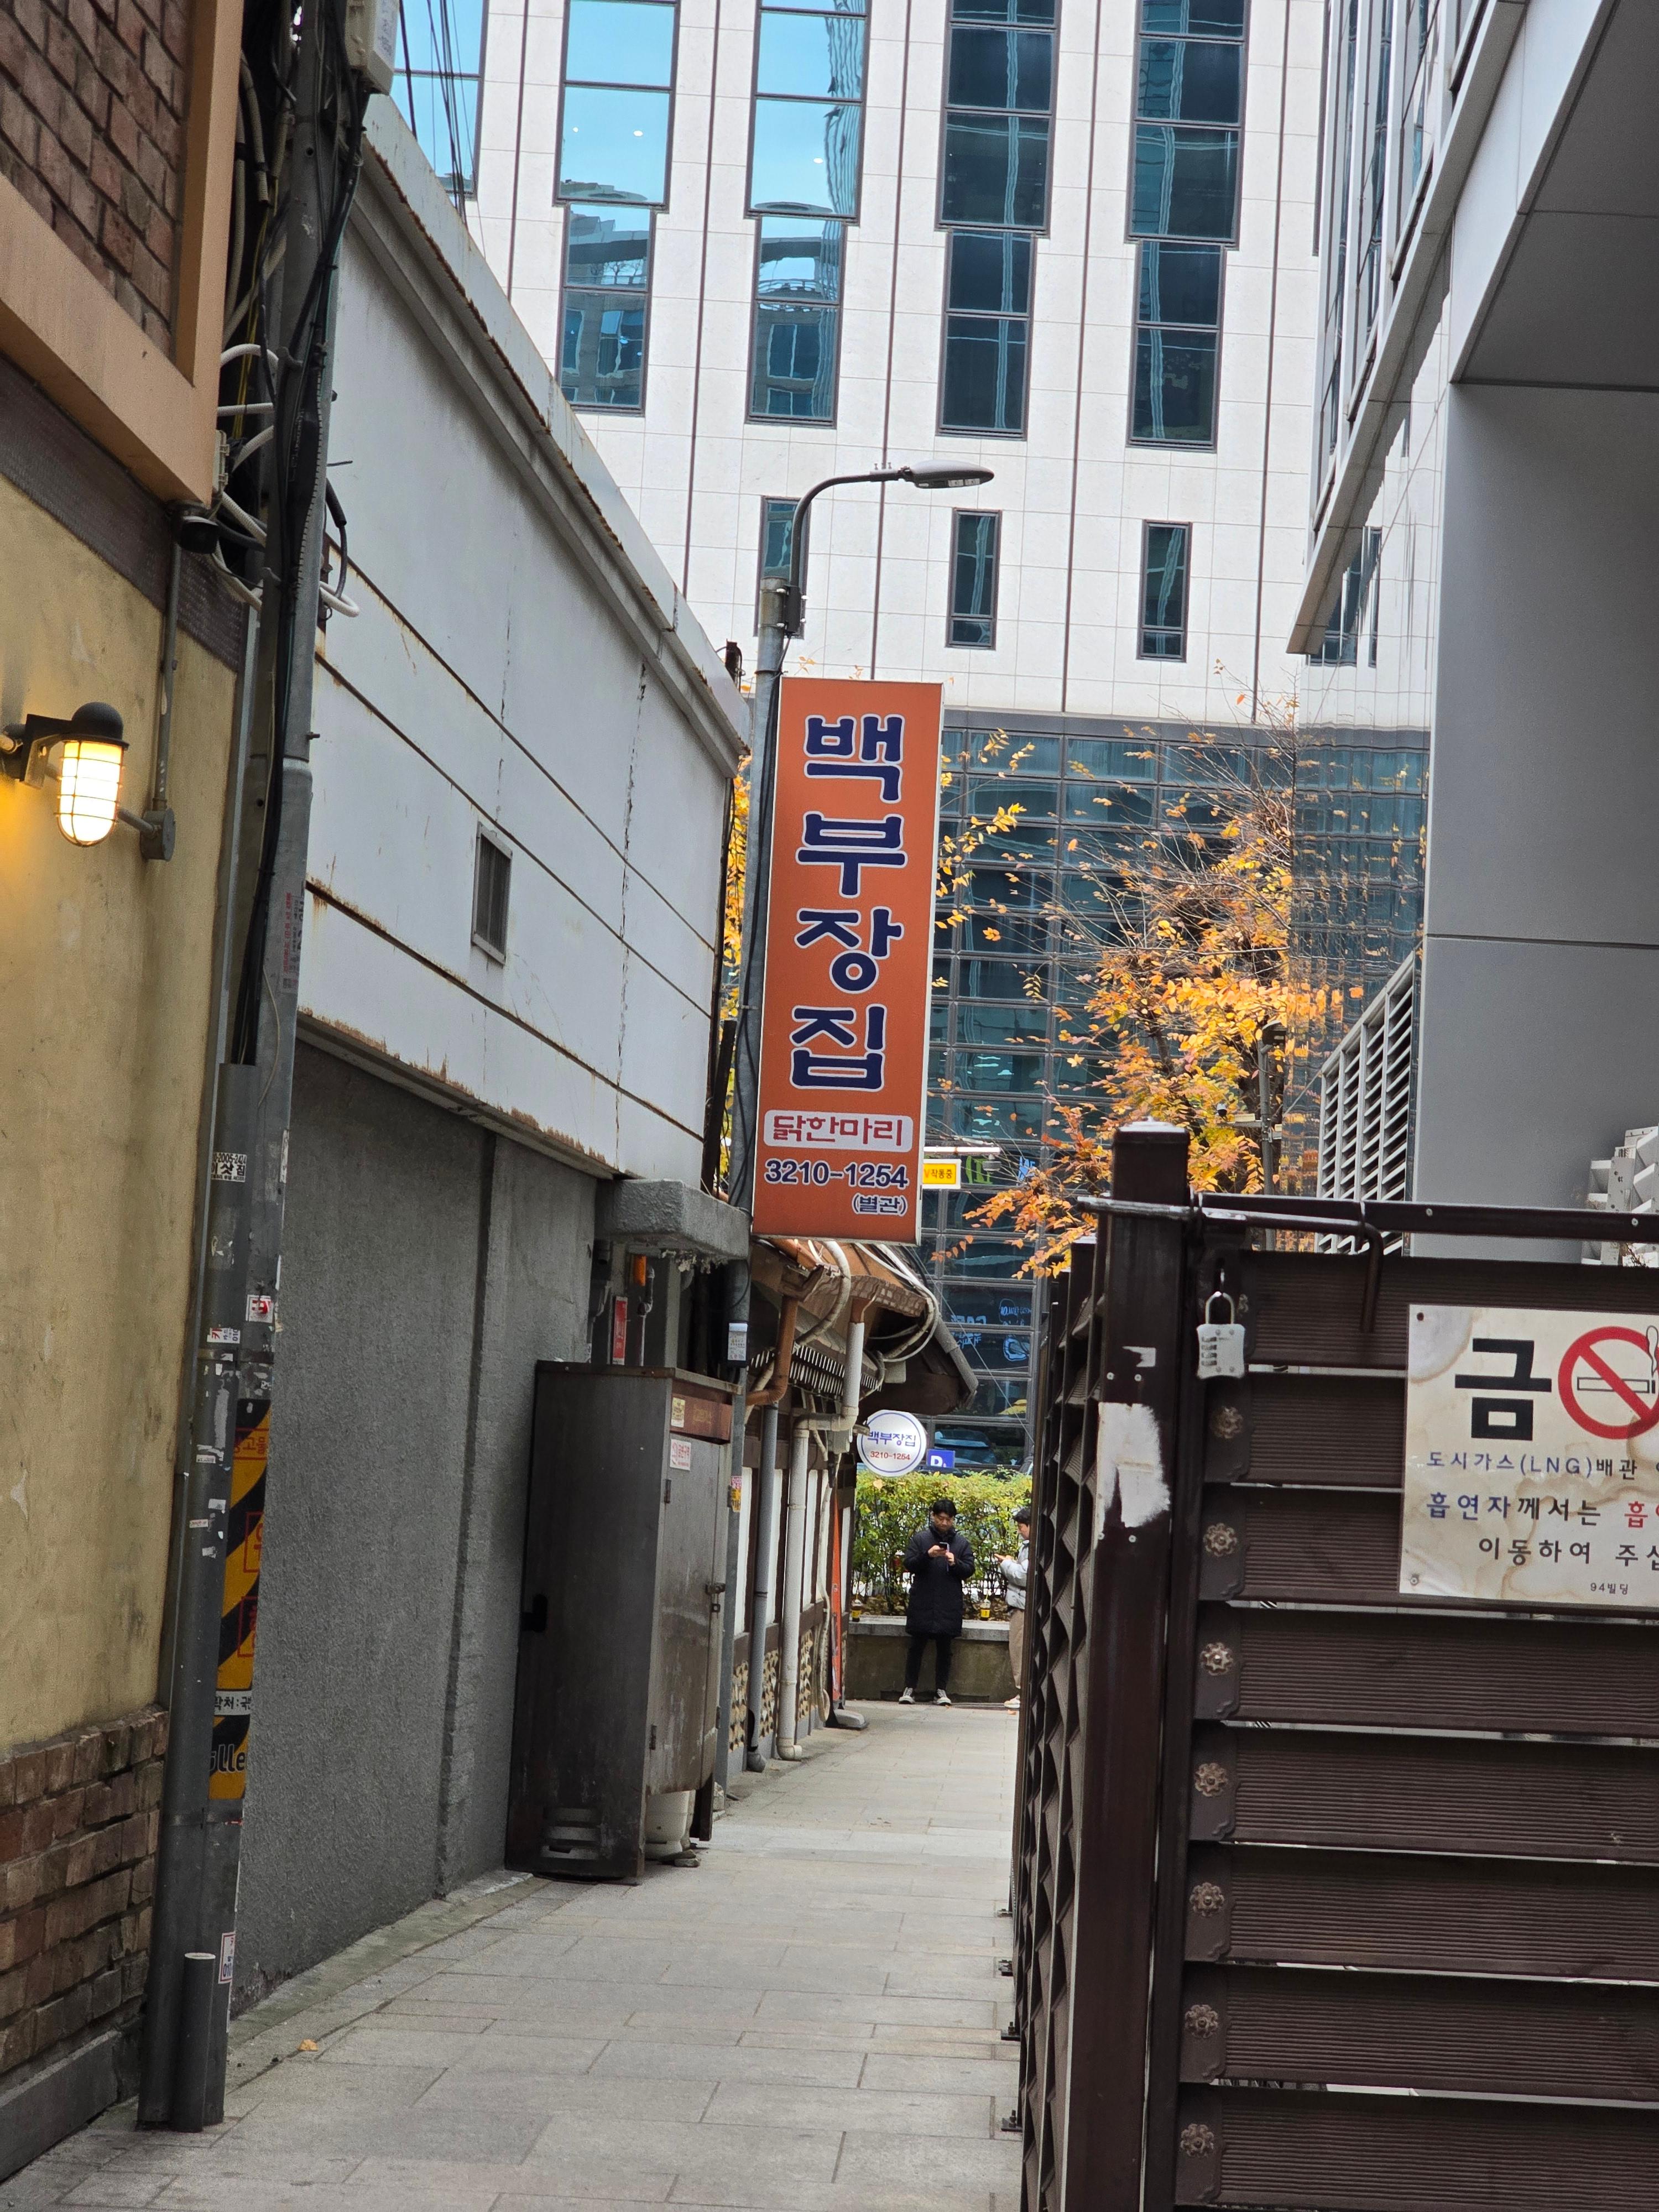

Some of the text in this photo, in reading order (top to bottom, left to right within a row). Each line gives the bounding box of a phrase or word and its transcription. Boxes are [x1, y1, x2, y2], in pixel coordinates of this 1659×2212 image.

[790, 714, 907, 1092] 백부장집
[773, 1115, 902, 1146] 닭한마리
[764, 1158, 910, 1189] 3210-1254
[852, 1193, 907, 1215] (별관)
[1455, 1337, 1552, 1441] 금
[867, 1431, 916, 1447] 백부장집
[870, 1451, 911, 1460] 3210-1254
[1426, 1451, 1637, 1480] 도시가스(LNG)배관
[1426, 1491, 1659, 1528] 흡연자께서는 흡
[1478, 1536, 1590, 1566] 이동하여
[1590, 1582, 1629, 1595] 94빌딩
